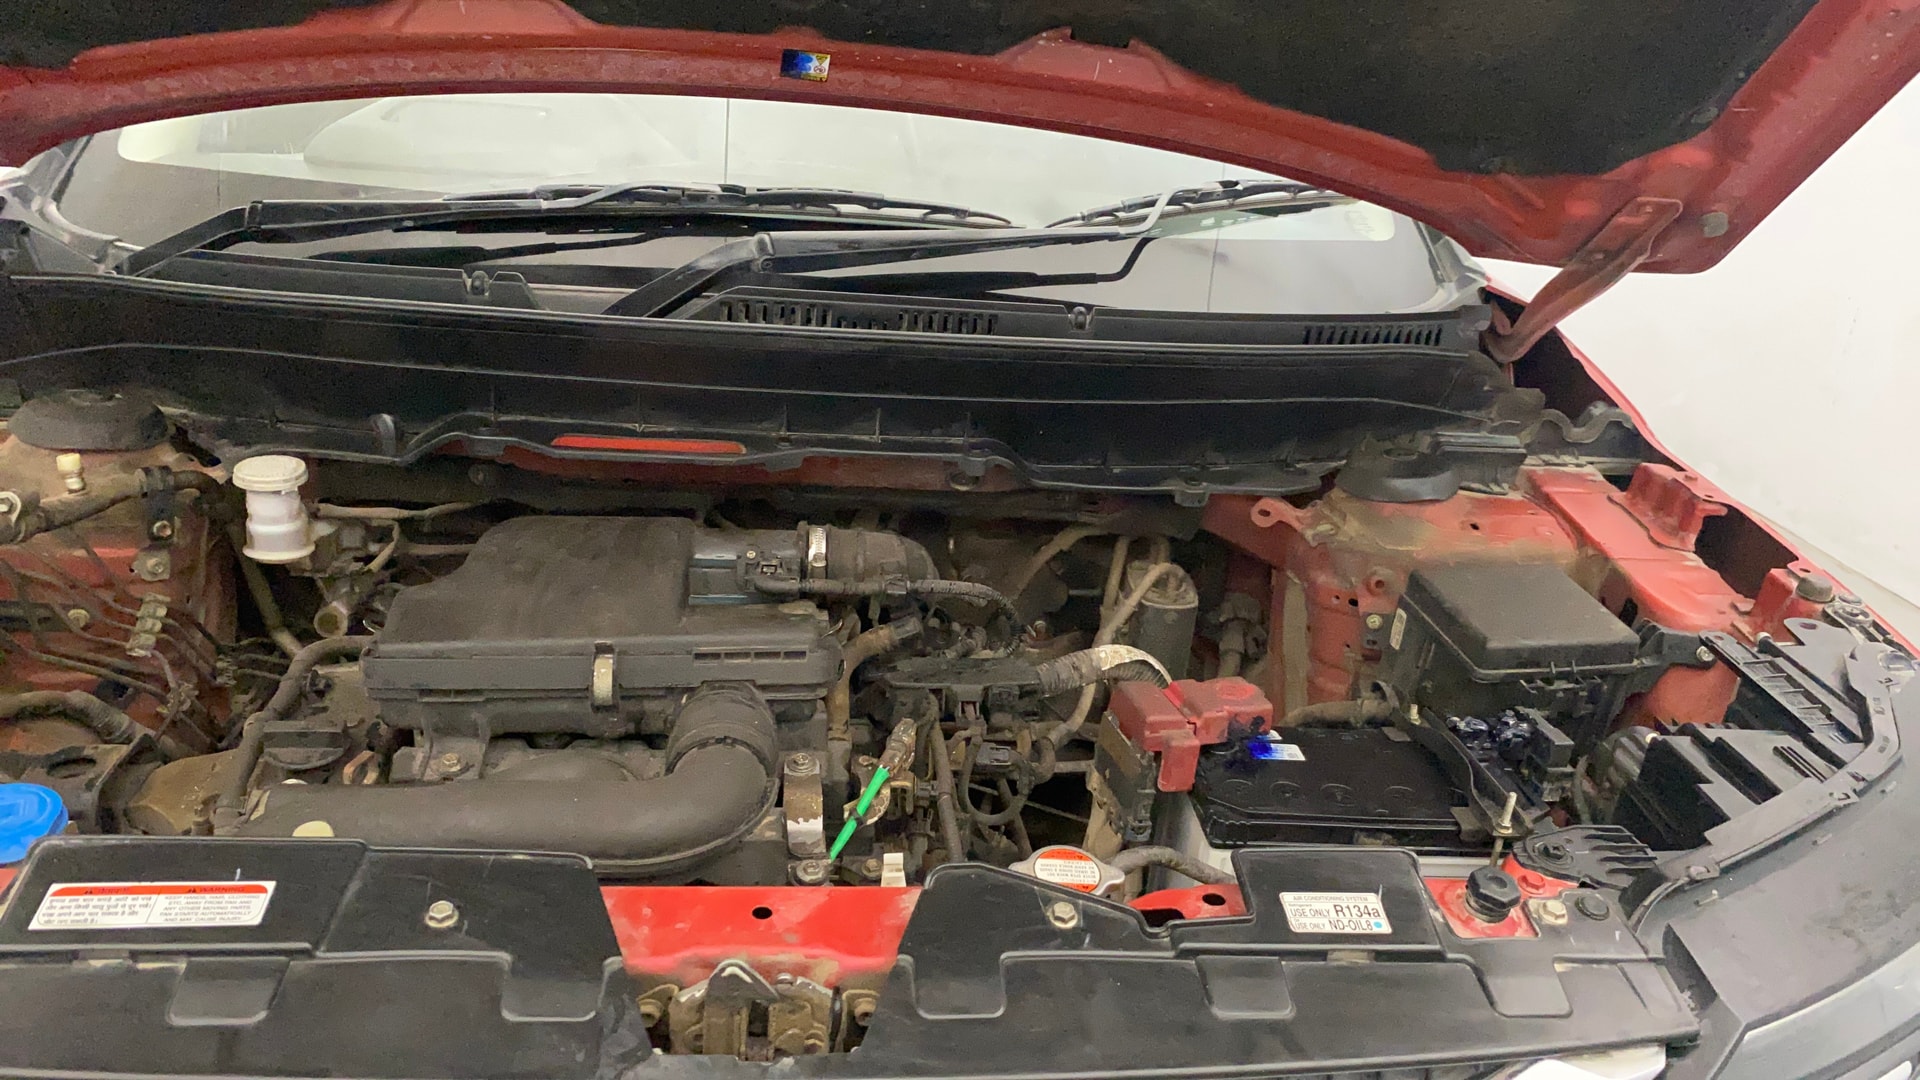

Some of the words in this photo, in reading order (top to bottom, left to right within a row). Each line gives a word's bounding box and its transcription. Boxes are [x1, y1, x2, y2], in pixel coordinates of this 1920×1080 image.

[1290, 908, 1308, 917] USE
[1309, 908, 1330, 917] ONLY
[1333, 904, 1380, 918] R134a
[1328, 920, 1374, 931] ND-OIL8
